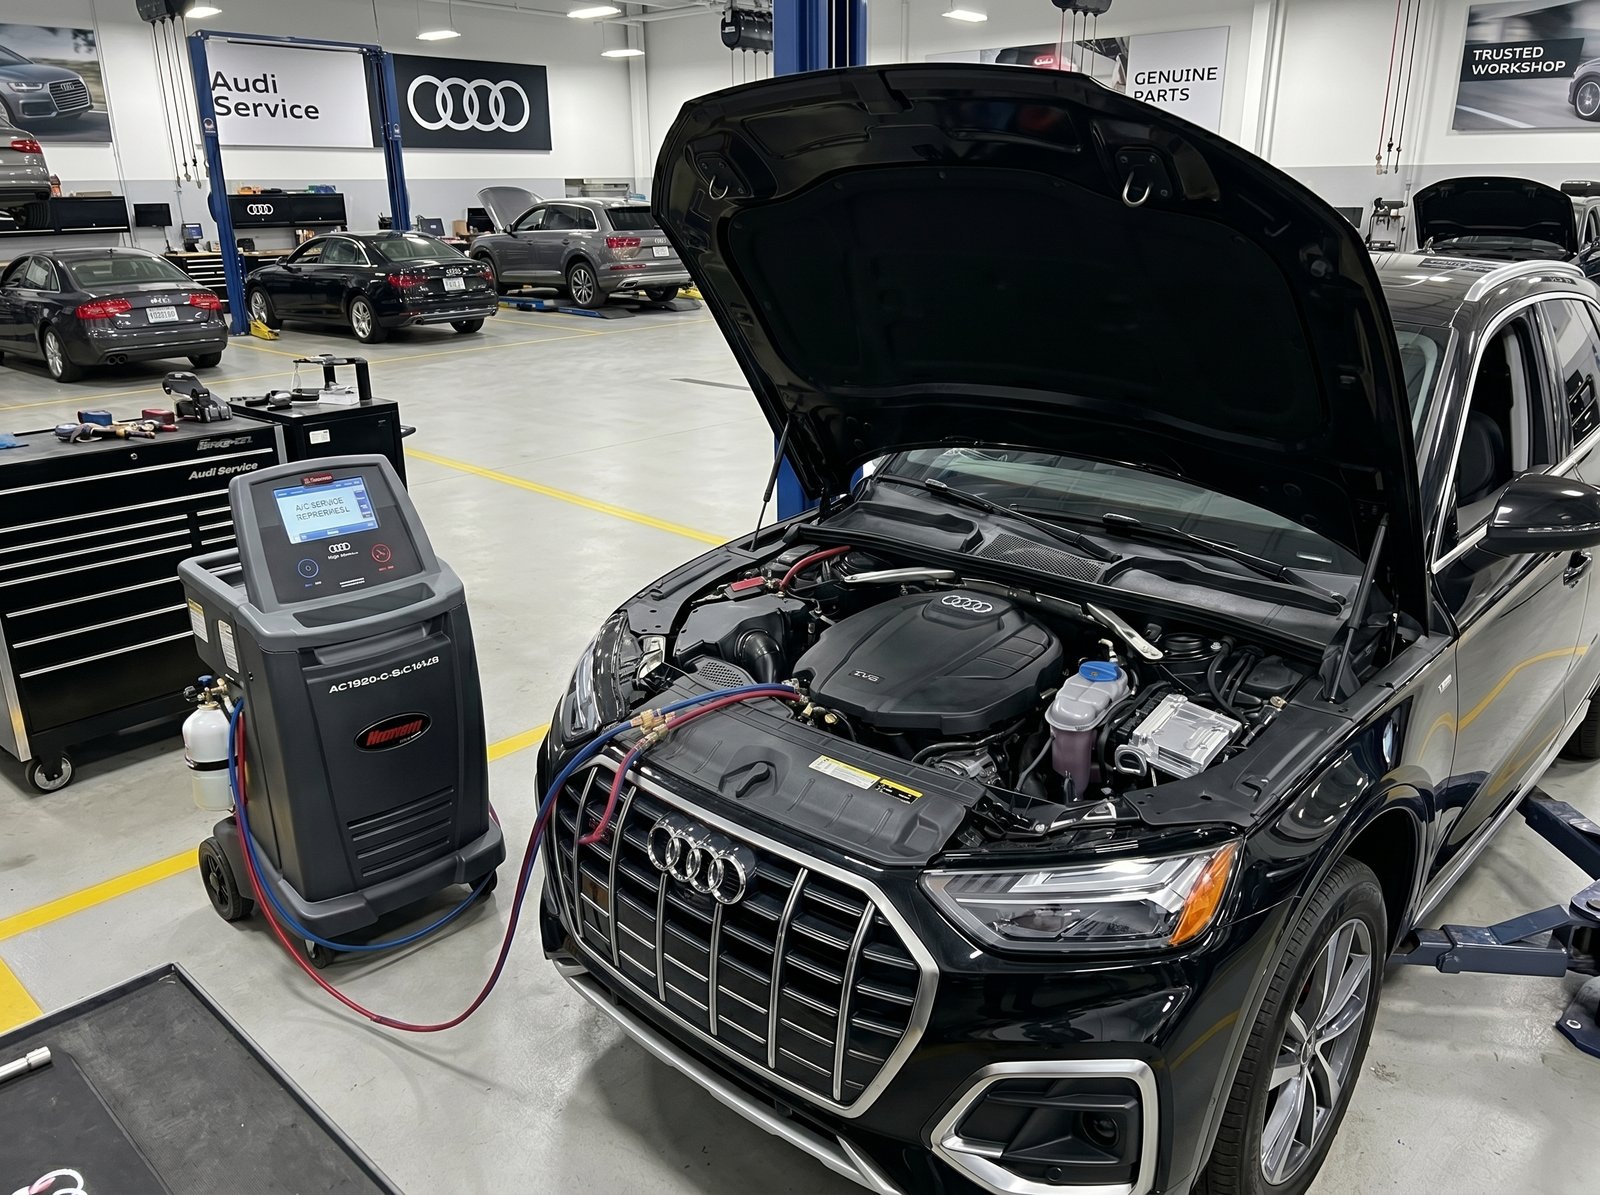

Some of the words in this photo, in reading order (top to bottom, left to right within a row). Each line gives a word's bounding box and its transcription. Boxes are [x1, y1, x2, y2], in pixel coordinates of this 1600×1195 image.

[1473, 46, 1544, 61] TRUSTED
[1134, 67, 1218, 85] GENUINE
[1472, 61, 1566, 75] WORKSHOP
[211, 71, 278, 94] Audi
[1134, 88, 1190, 102] PARTS
[213, 95, 320, 120] Service
[188, 467, 217, 480] Audi
[217, 462, 258, 476] Service
